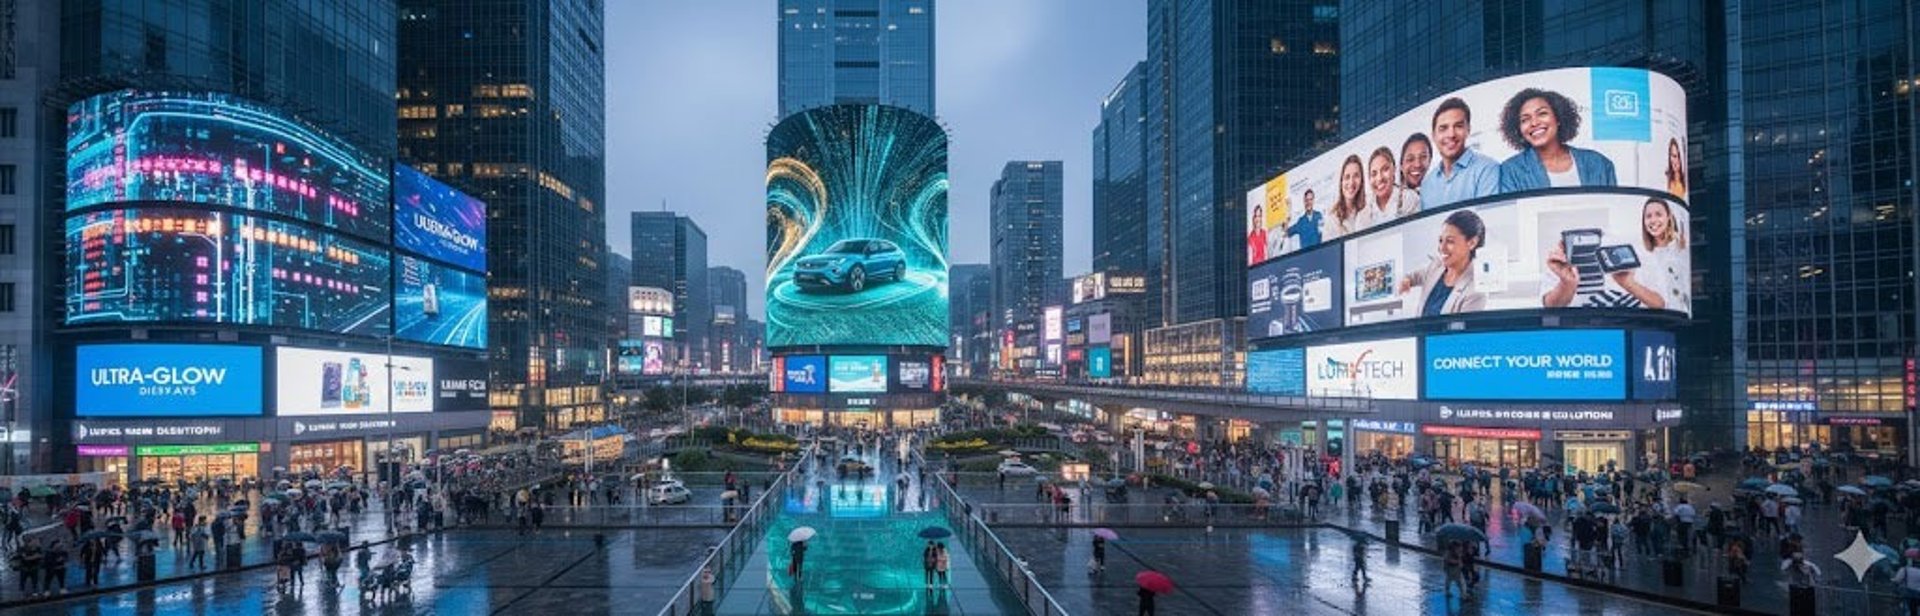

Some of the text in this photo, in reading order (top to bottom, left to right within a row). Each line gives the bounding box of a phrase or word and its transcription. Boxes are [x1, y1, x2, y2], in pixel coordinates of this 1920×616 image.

[1433, 354, 1613, 370] CONNECT YOUR WORLD
[91, 366, 227, 386] ULTRA-GLOW
